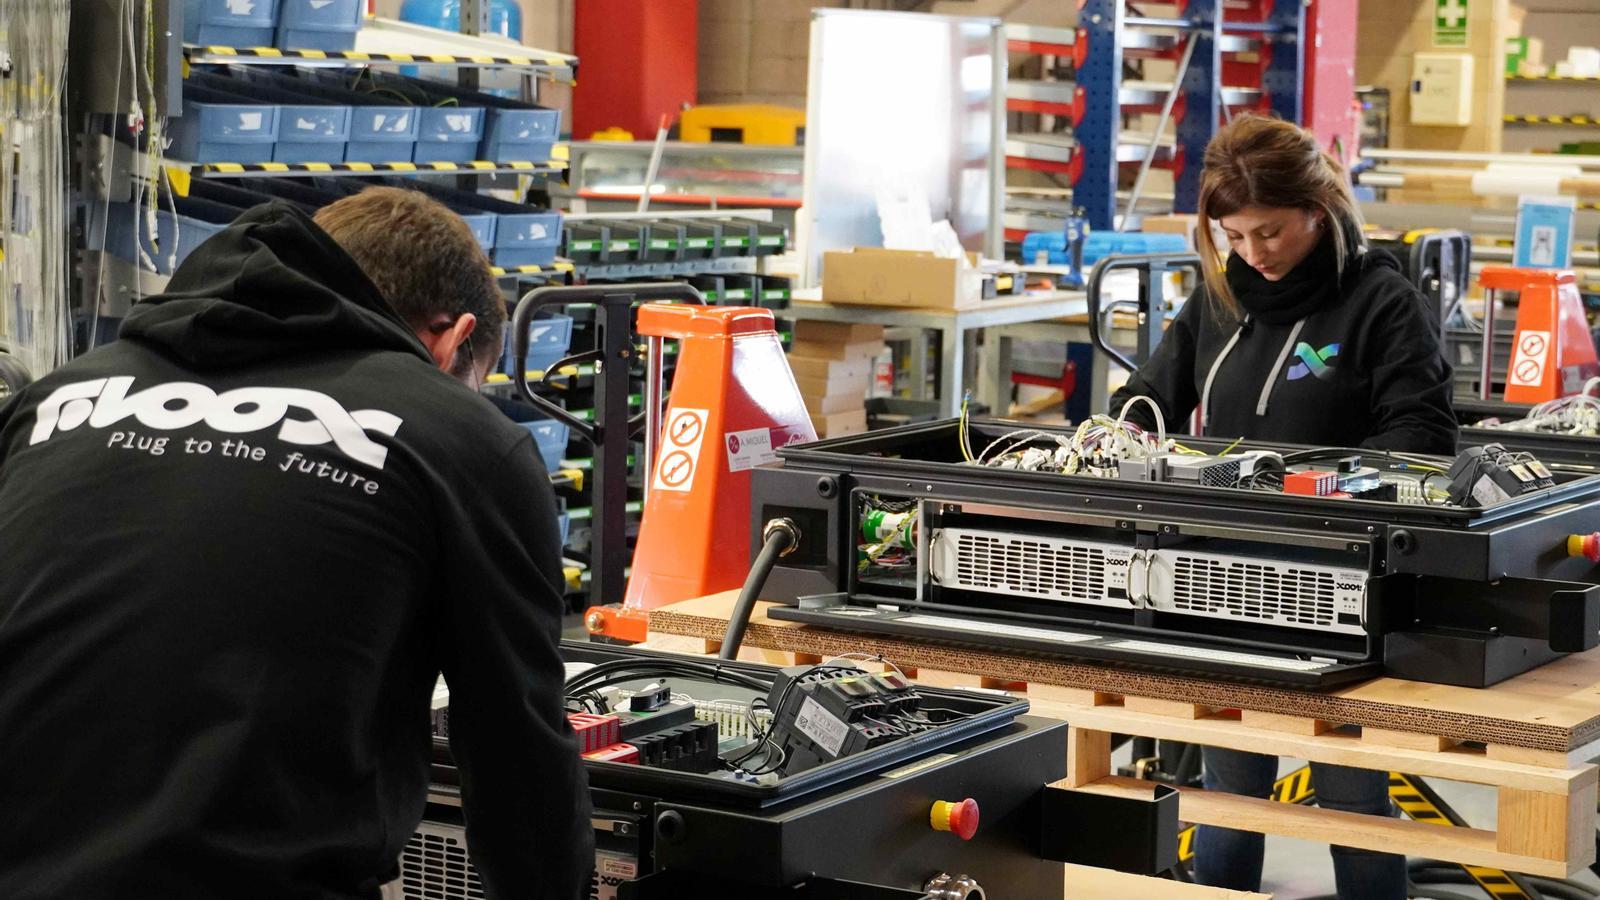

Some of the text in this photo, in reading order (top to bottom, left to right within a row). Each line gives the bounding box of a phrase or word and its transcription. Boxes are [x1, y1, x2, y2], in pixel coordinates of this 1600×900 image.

[108, 431, 378, 494] Plug to the future
